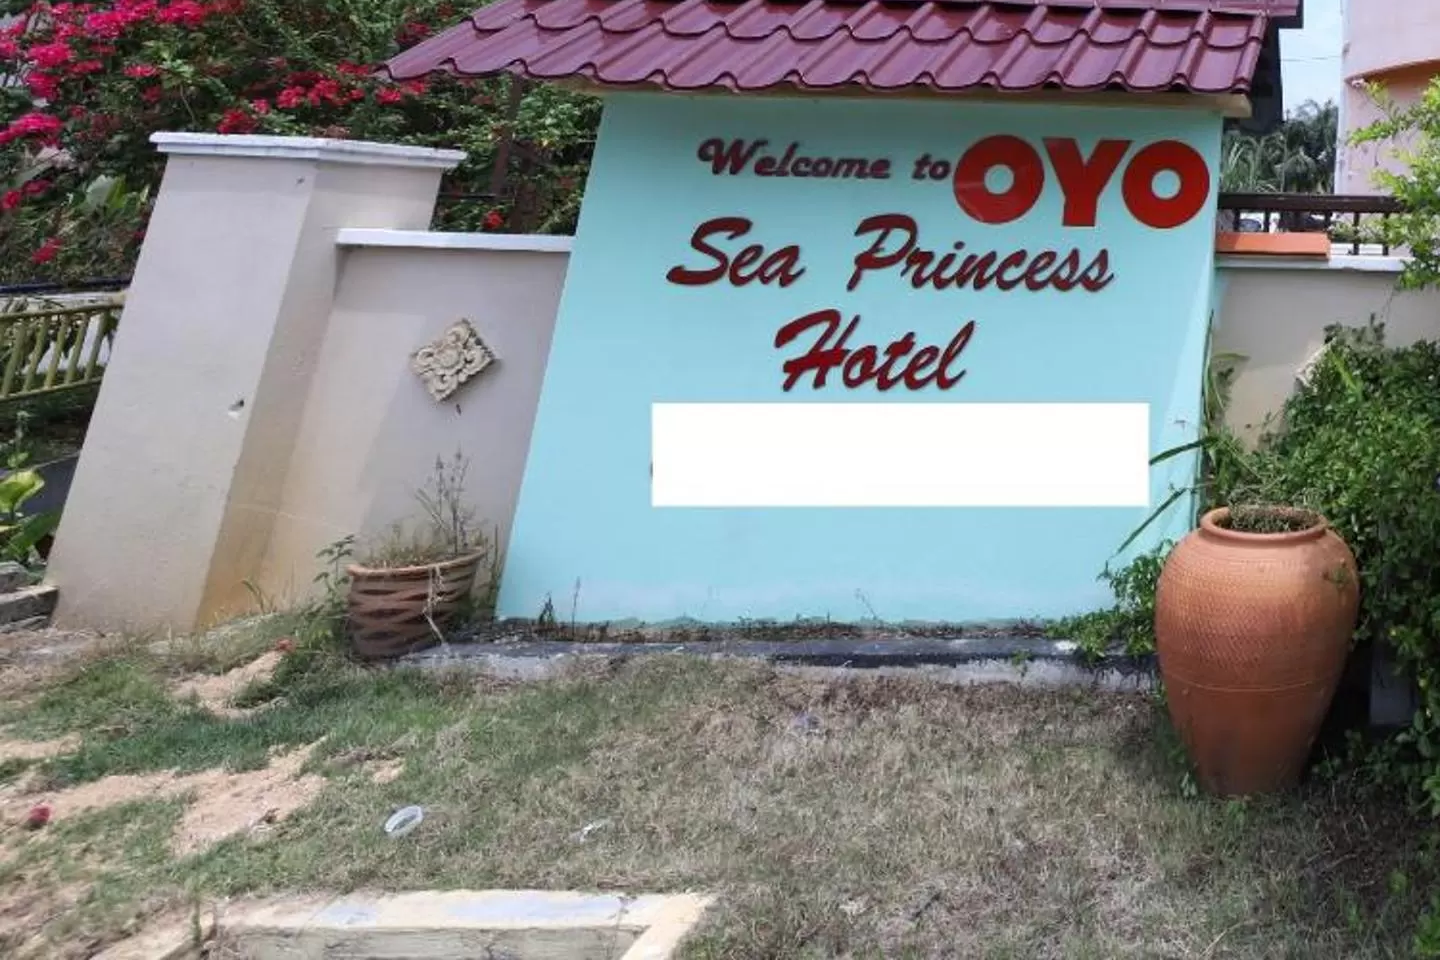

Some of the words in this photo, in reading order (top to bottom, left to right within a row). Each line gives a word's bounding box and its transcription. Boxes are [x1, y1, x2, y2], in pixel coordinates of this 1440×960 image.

[697, 137, 892, 181] Welcome
[911, 152, 954, 182] to
[953, 134, 1211, 229] OYO
[665, 216, 806, 289] Sea
[846, 214, 1115, 292] Princess
[774, 309, 976, 393] Hotel
